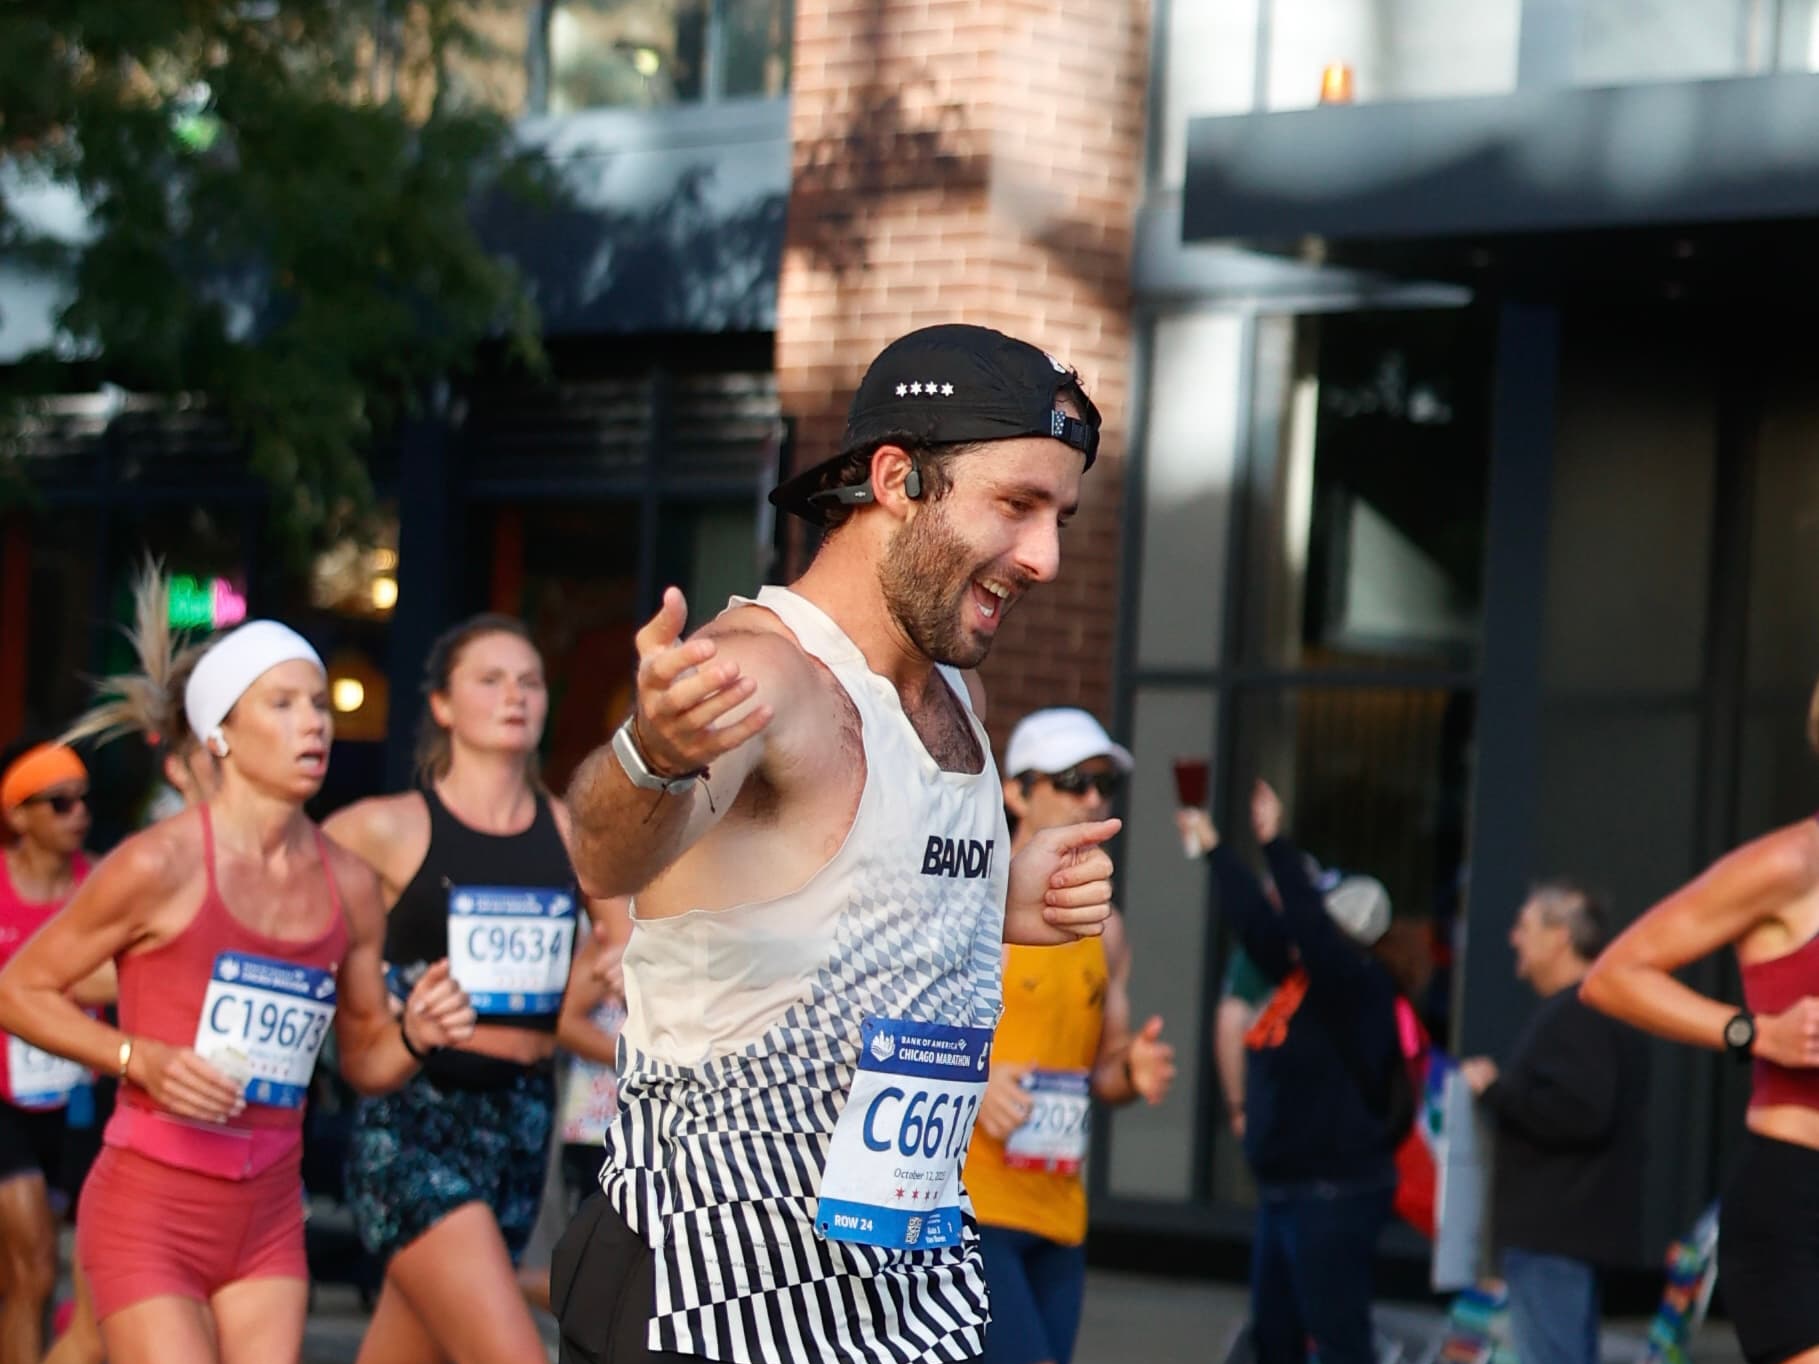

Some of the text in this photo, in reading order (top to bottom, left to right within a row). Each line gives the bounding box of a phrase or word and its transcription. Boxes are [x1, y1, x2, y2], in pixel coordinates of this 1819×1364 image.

[468, 924, 562, 962] C9634
[210, 992, 327, 1054] C19673
[901, 1036, 958, 1050] BANK OF AMERICA
[899, 1048, 971, 1067] CHICAGO MARATHON
[894, 1167, 924, 1180] October
[834, 1214, 873, 1232] ROW 24
